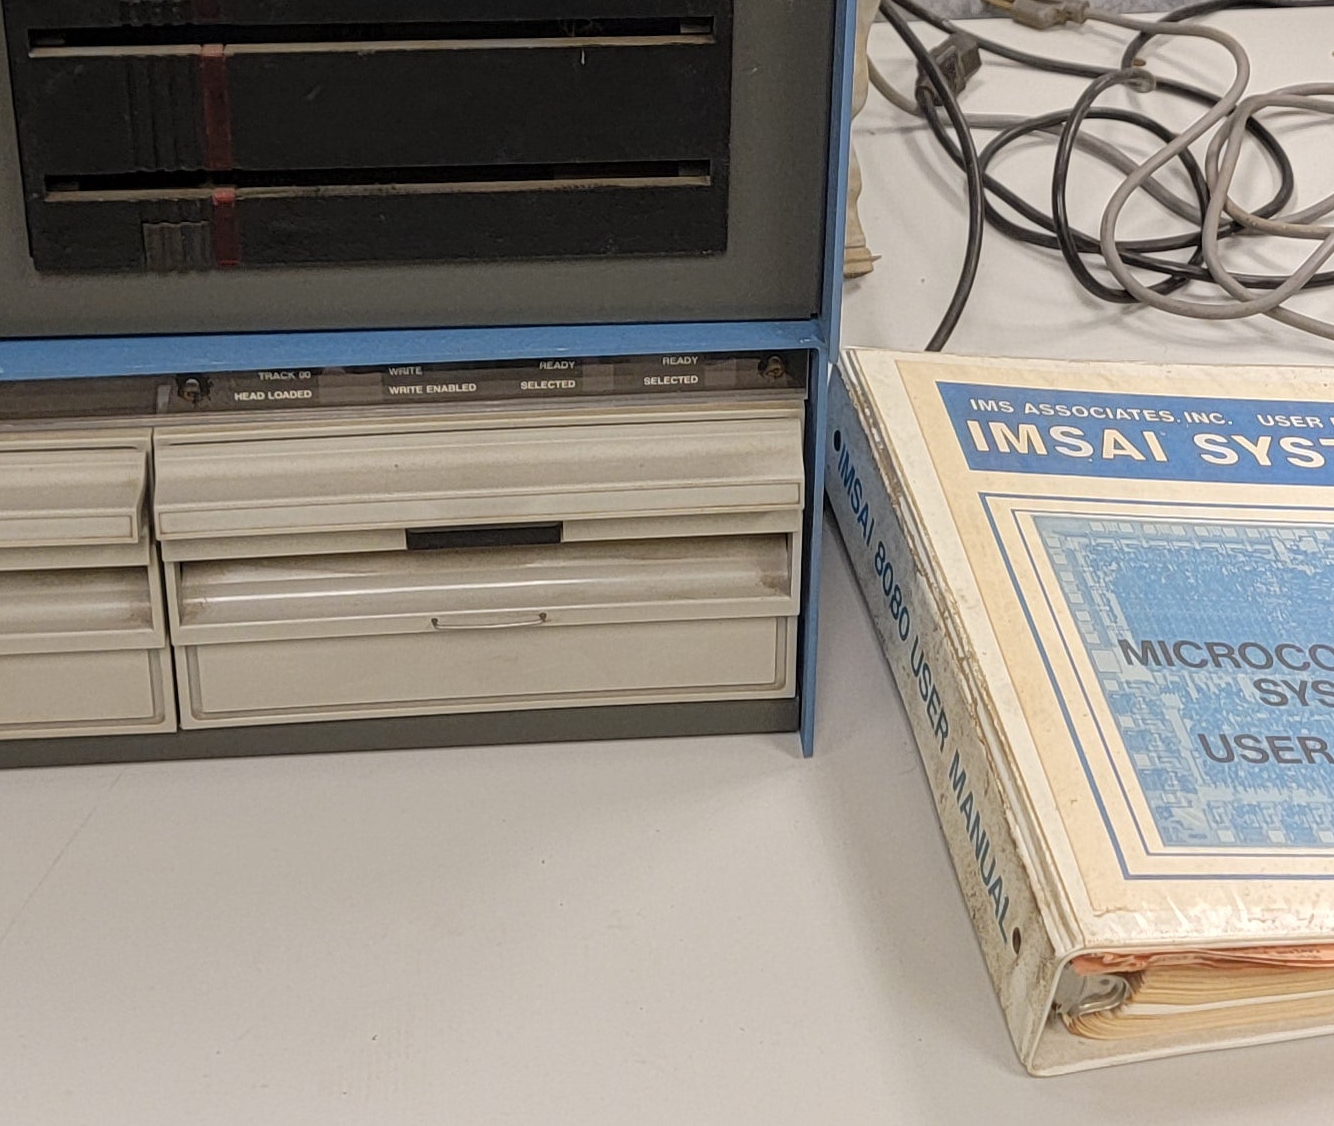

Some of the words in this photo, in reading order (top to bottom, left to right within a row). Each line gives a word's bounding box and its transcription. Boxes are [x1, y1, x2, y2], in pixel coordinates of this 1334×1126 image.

[538, 360, 576, 371] READY
[662, 355, 699, 366] READY
[258, 371, 295, 381] TRACK
[388, 366, 423, 376] WRITE
[520, 379, 576, 390] SELECTED
[643, 375, 699, 386] SELECTED
[388, 385, 423, 395] WRITE
[426, 383, 477, 393] ENABLED
[234, 391, 265, 401] HEAD
[268, 389, 313, 400] LOADED
[969, 397, 1015, 414] IMS
[1183, 411, 1234, 426] INC.
[1257, 413, 1325, 429] USER
[967, 420, 1169, 463] IMSAI
[837, 446, 875, 546] IMSAI
[873, 540, 911, 643] 8080
[910, 635, 951, 753] USER
[948, 748, 1009, 944] MANUAL
